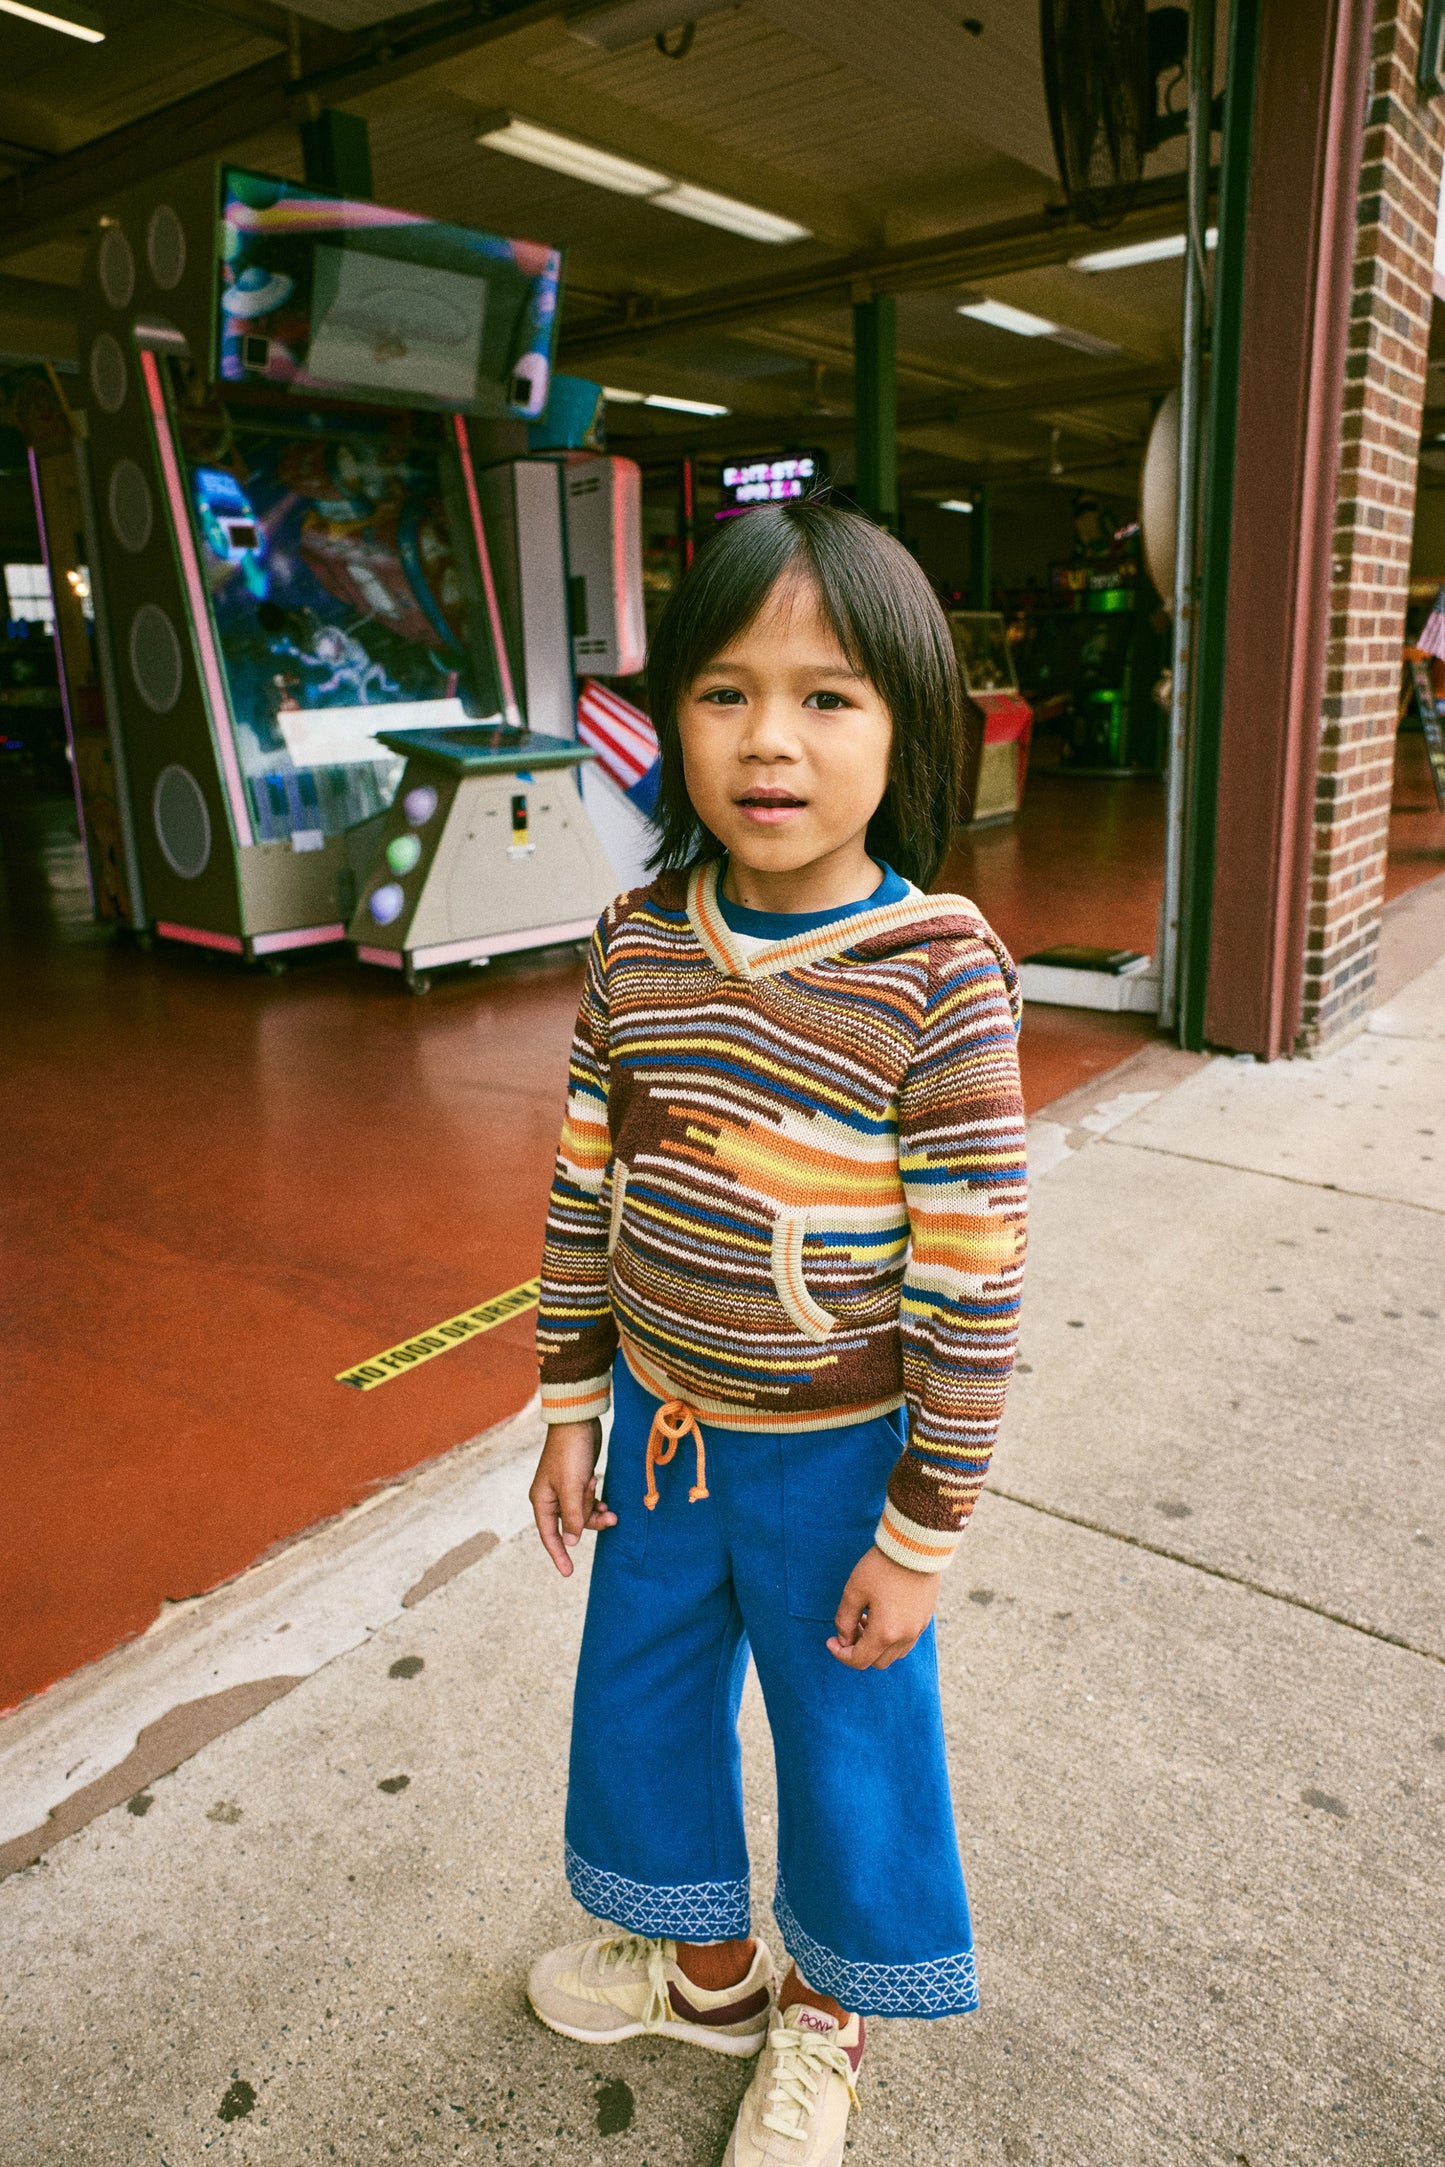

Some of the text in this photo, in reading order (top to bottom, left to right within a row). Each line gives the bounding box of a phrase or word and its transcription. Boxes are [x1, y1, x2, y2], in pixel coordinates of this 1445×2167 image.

[340, 1289, 535, 1389] NO FOOD OR DRINK
[799, 2013, 834, 2032] PONY
